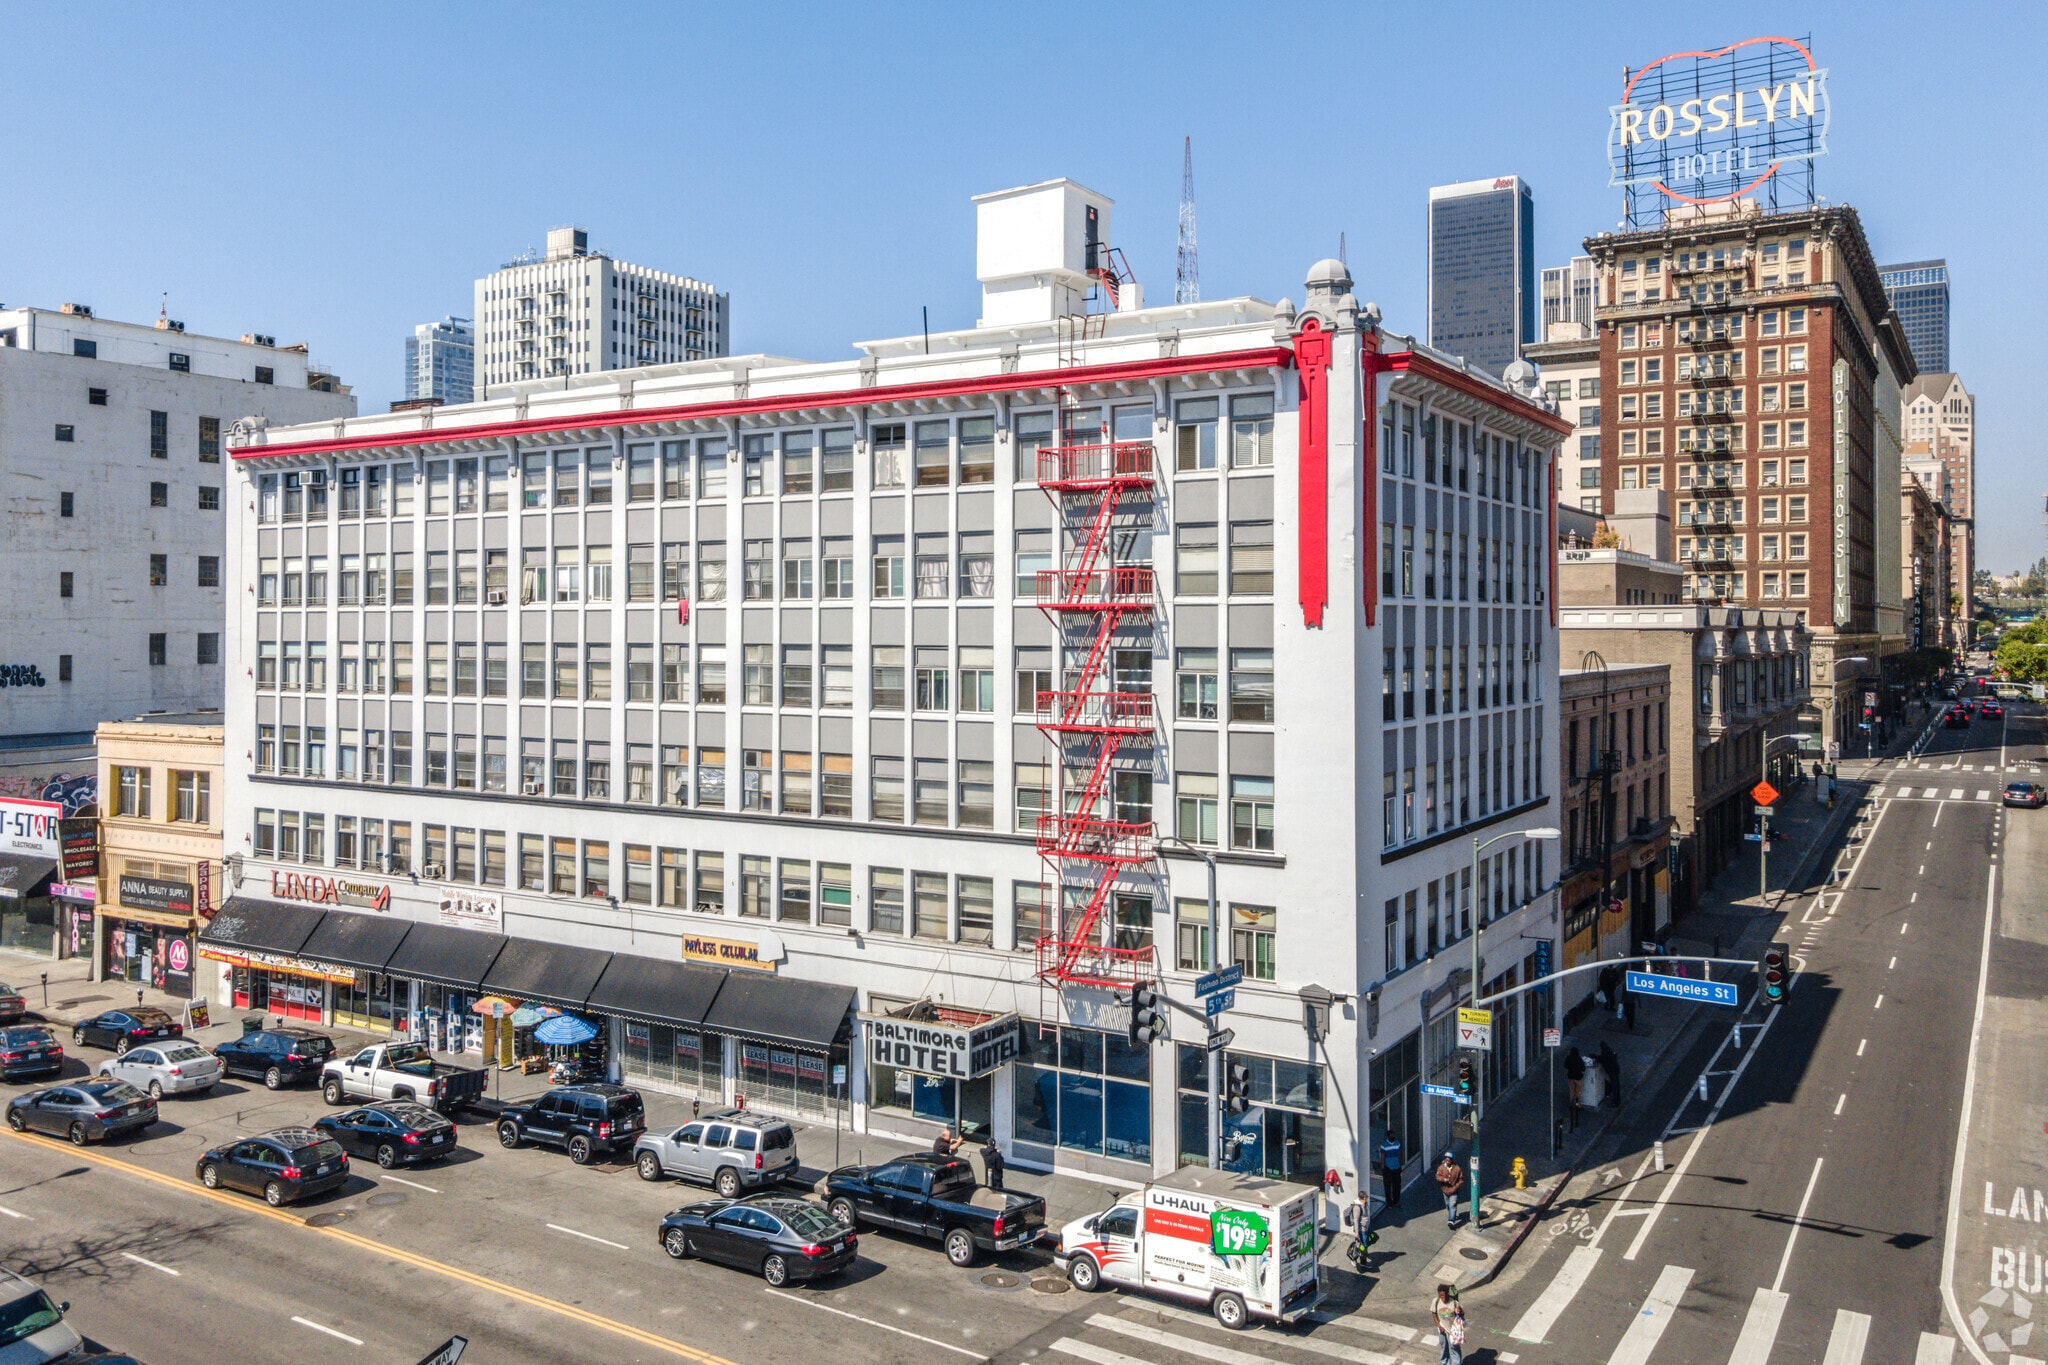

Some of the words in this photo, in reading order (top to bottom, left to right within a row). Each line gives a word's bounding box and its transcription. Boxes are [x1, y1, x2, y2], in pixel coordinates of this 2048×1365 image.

[1619, 78, 1815, 146] ROSSLYN
[1673, 146, 1760, 181] HOTEL
[1834, 369, 1844, 464] HOTEL
[1835, 484, 1845, 618] ROSSLYN
[12, 840, 43, 850] ELECTRONICS
[64, 845, 96, 854] WHOLESALE
[121, 880, 147, 895] ANNA
[148, 885, 168, 897] BEAUTY
[169, 887, 190, 898] SUPPLY
[271, 869, 339, 904] LINDA
[338, 879, 380, 896] Company
[684, 938, 717, 956] PAYLESS
[720, 944, 759, 962] CELLULAR
[1197, 979, 1219, 992] Fashion
[1219, 971, 1240, 984] District
[1634, 976, 1655, 989] Los
[1660, 980, 1709, 996] Angeles
[1715, 987, 1729, 999] St
[681, 1038, 698, 1048] LEASE
[875, 1021, 966, 1050] BALTIMORE
[747, 1050, 766, 1061] LEASE
[774, 1056, 794, 1066] LEASE
[802, 1060, 823, 1071] LEASE
[875, 1038, 966, 1077] HOTEL
[971, 1036, 1018, 1074] HOTEL
[1435, 1086, 1457, 1096] Angele
[1153, 1193, 1210, 1214] U-HAUL
[1219, 1213, 1232, 1222] Now
[1232, 1216, 1249, 1228] Only
[1154, 1254, 1175, 1263] PERFECT
[1186, 1260, 1205, 1269] MOVING
[1991, 1246, 2048, 1294] BU
